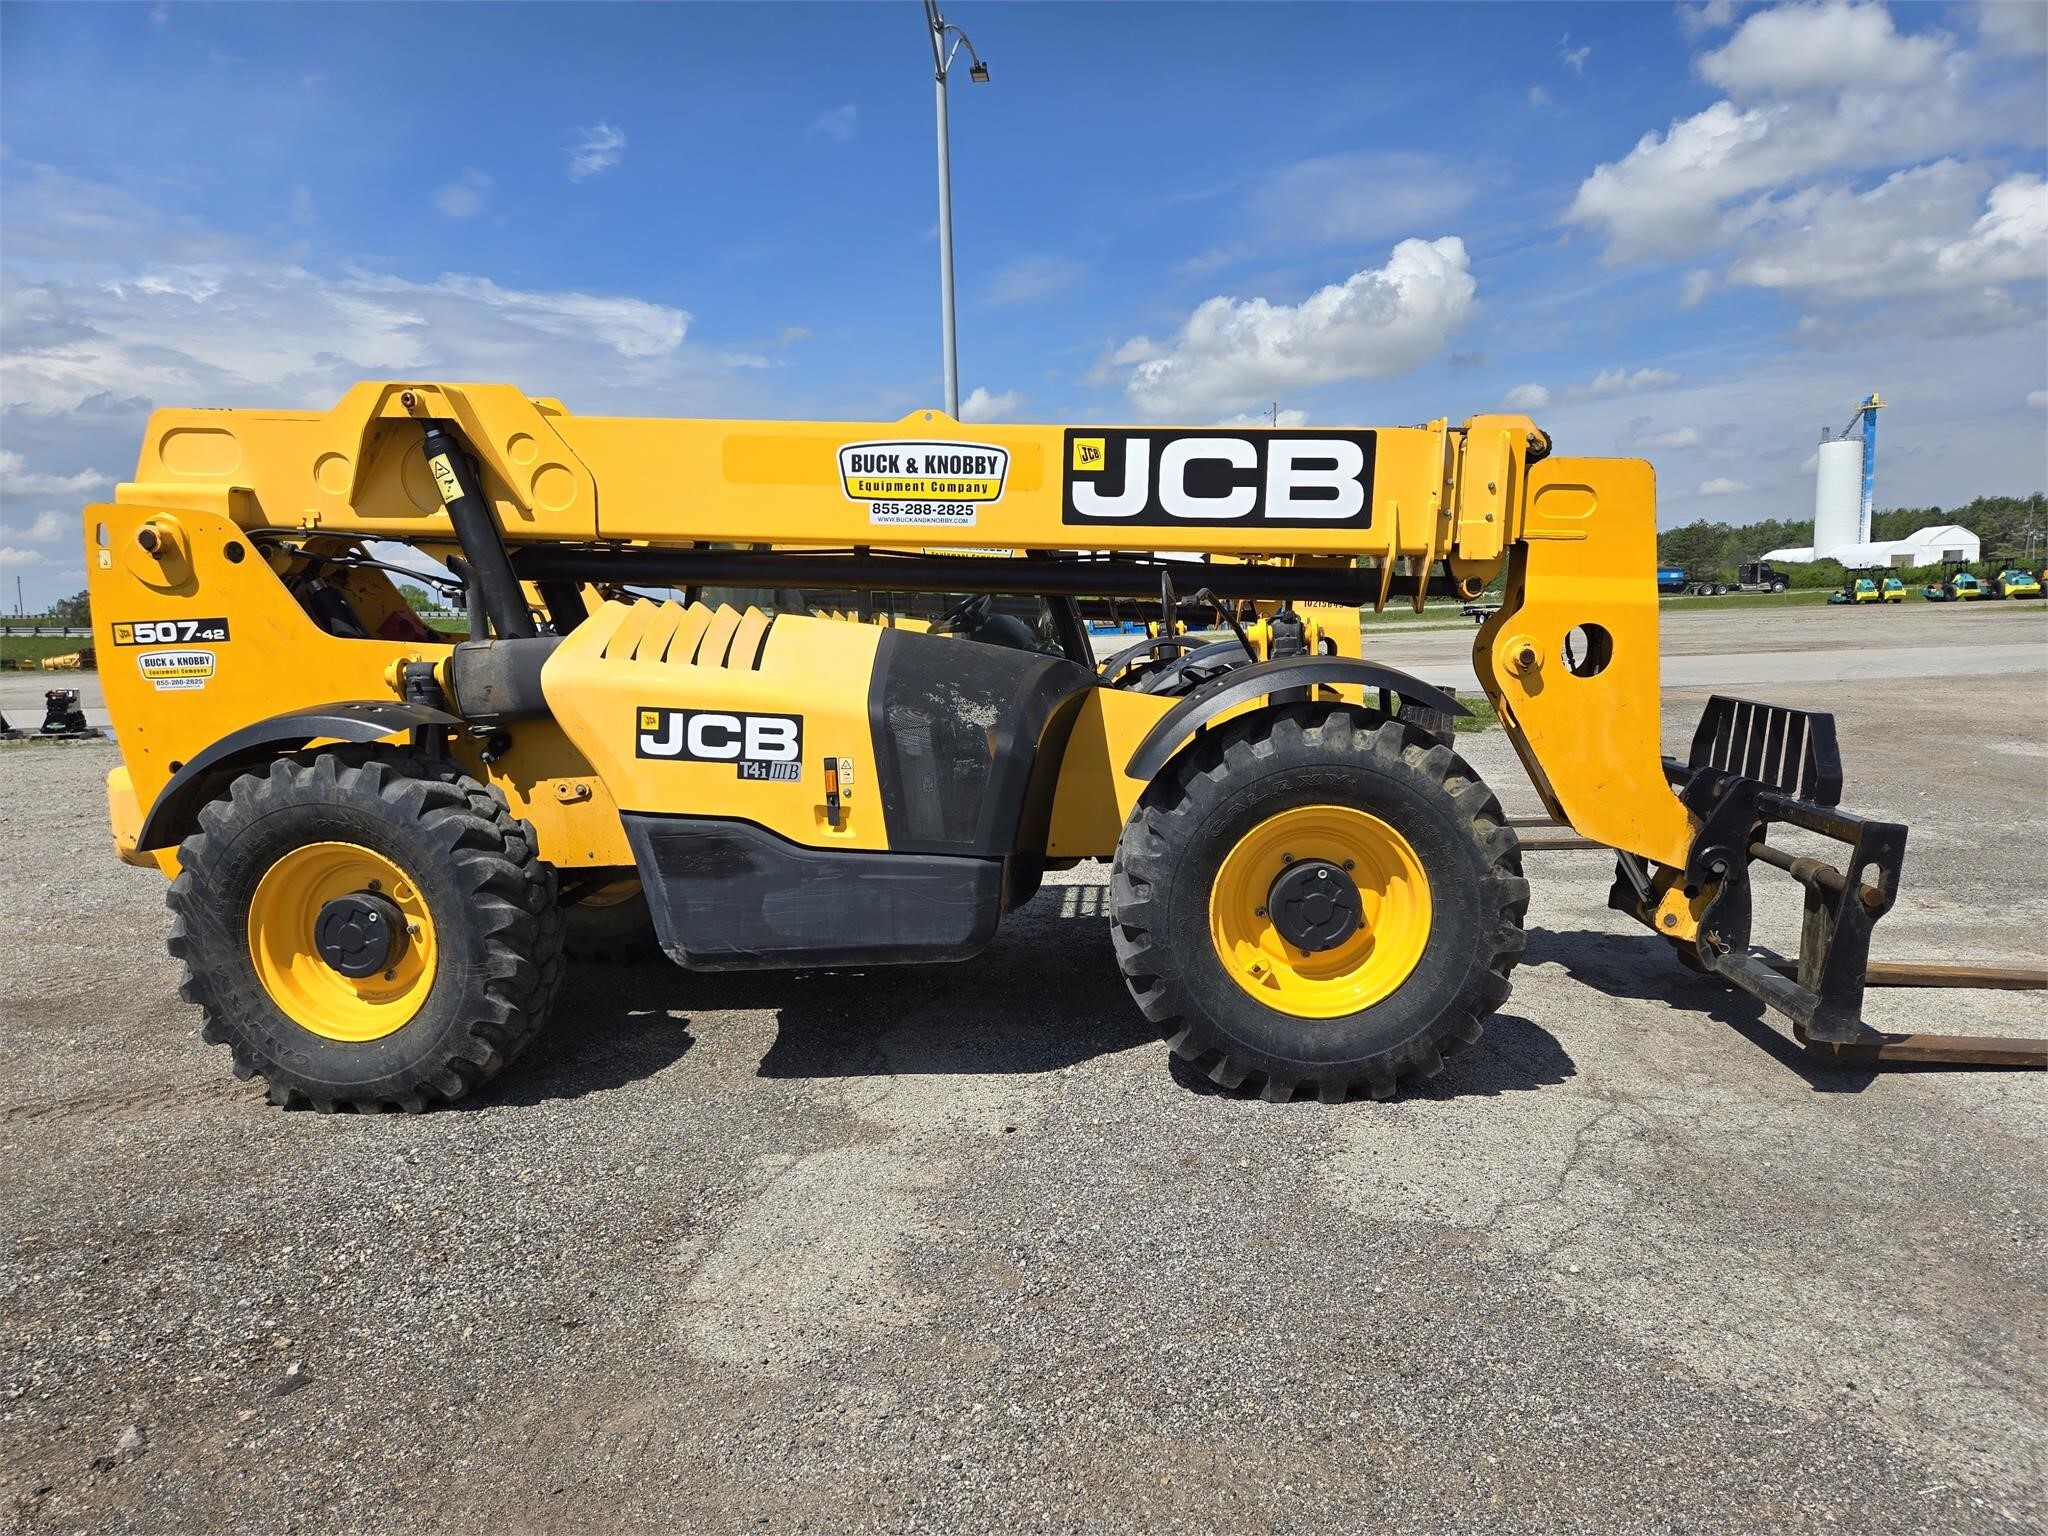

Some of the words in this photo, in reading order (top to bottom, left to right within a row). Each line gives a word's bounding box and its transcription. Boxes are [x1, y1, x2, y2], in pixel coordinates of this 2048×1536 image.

[1081, 445, 1100, 461] JCB
[851, 454, 900, 474] BUCK
[905, 457, 919, 474] &
[924, 455, 998, 475] KNOBBY
[858, 480, 925, 493] Equipment
[931, 481, 988, 494] Company
[1072, 437, 1365, 519] JCB
[872, 503, 974, 516] 855-288-2825
[877, 516, 969, 525] WWW.BUCKANDKNOBBY.COM
[134, 621, 225, 643] 507-42
[144, 658, 167, 667] BUCK
[177, 656, 210, 667] KNOBBY
[640, 712, 799, 761] JCB
[739, 761, 769, 779] T4i
[1207, 773, 1352, 837] GALAXY
